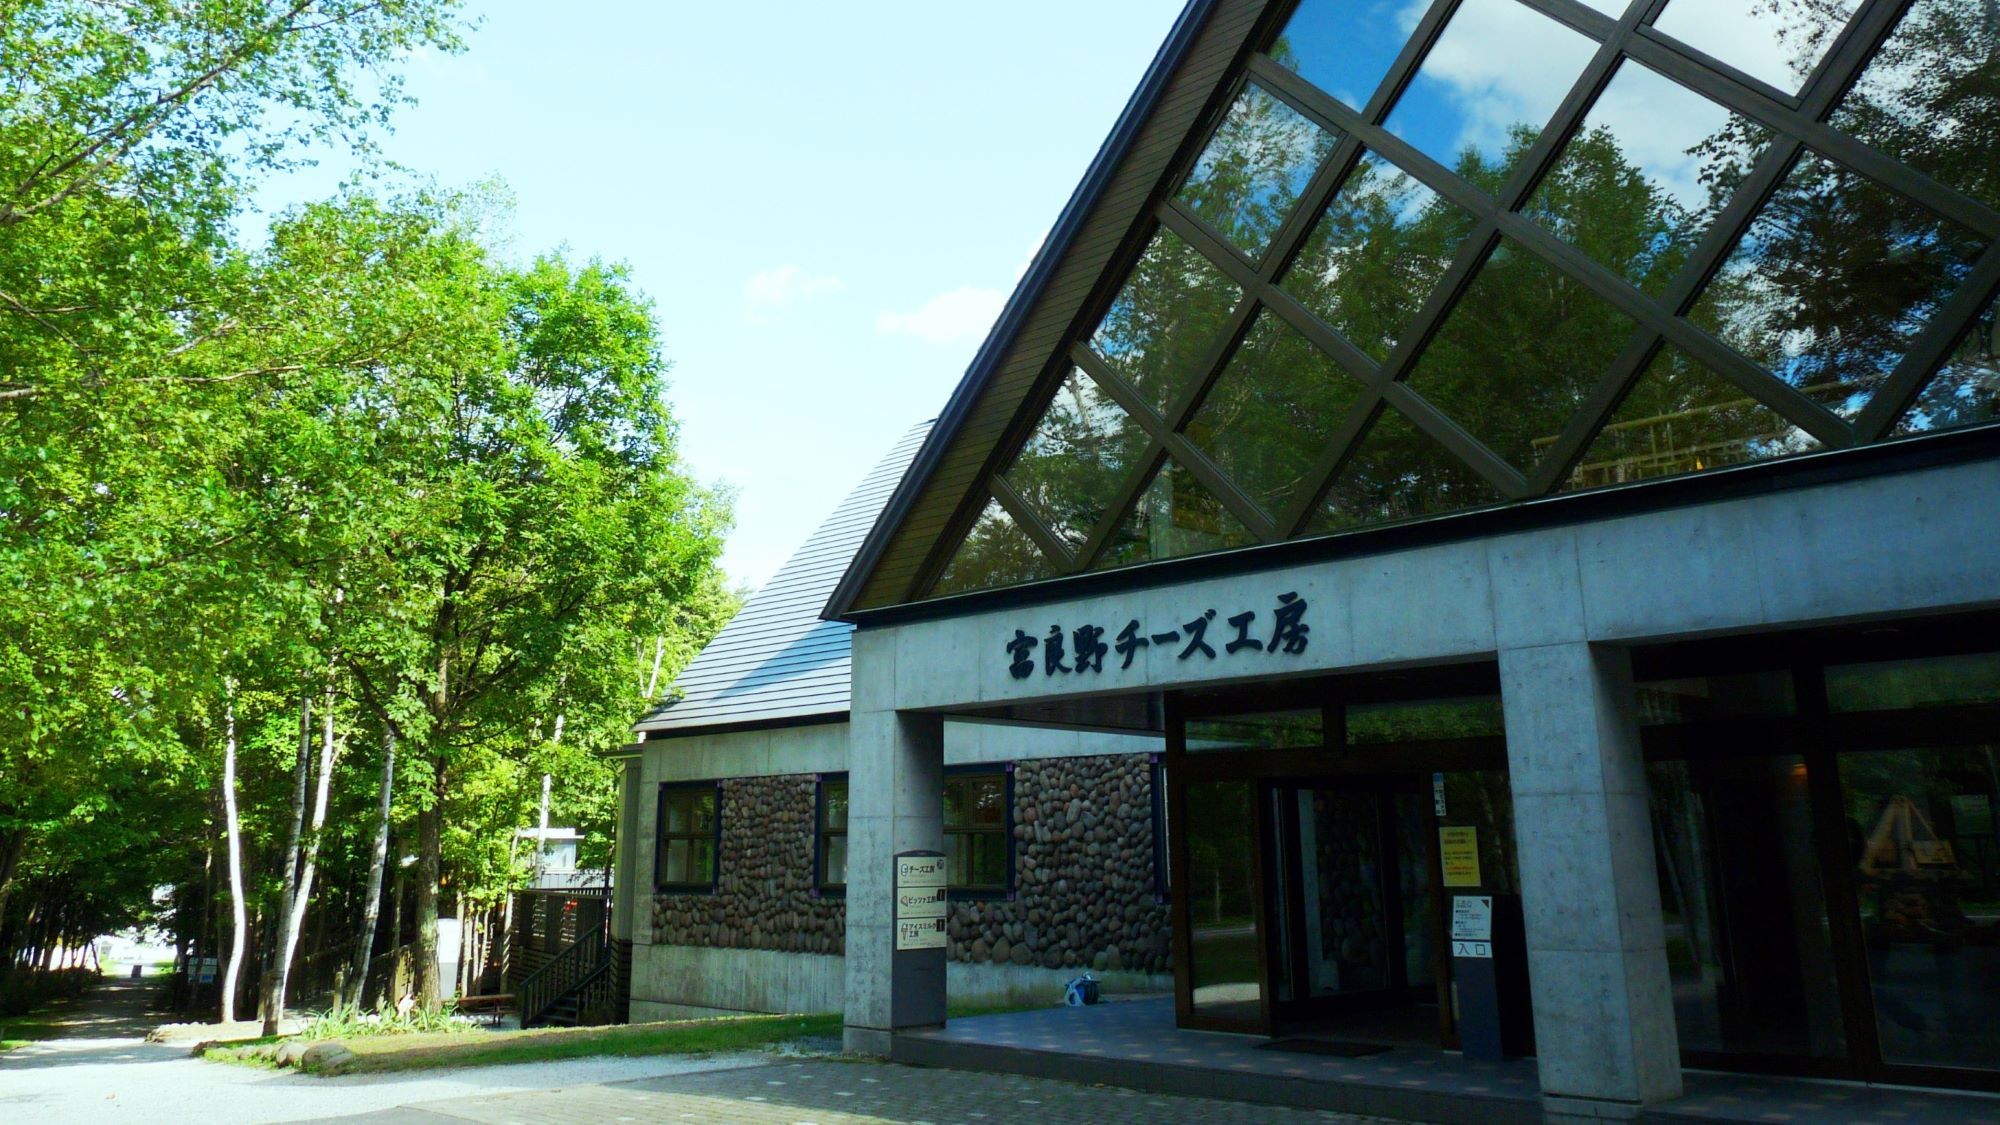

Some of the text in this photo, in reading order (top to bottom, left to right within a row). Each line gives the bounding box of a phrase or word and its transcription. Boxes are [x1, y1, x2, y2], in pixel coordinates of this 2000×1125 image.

[1006, 591, 1309, 679] 富良野チーズ工房
[909, 865, 935, 873] チーズ工房
[1458, 943, 1486, 955] 入口
